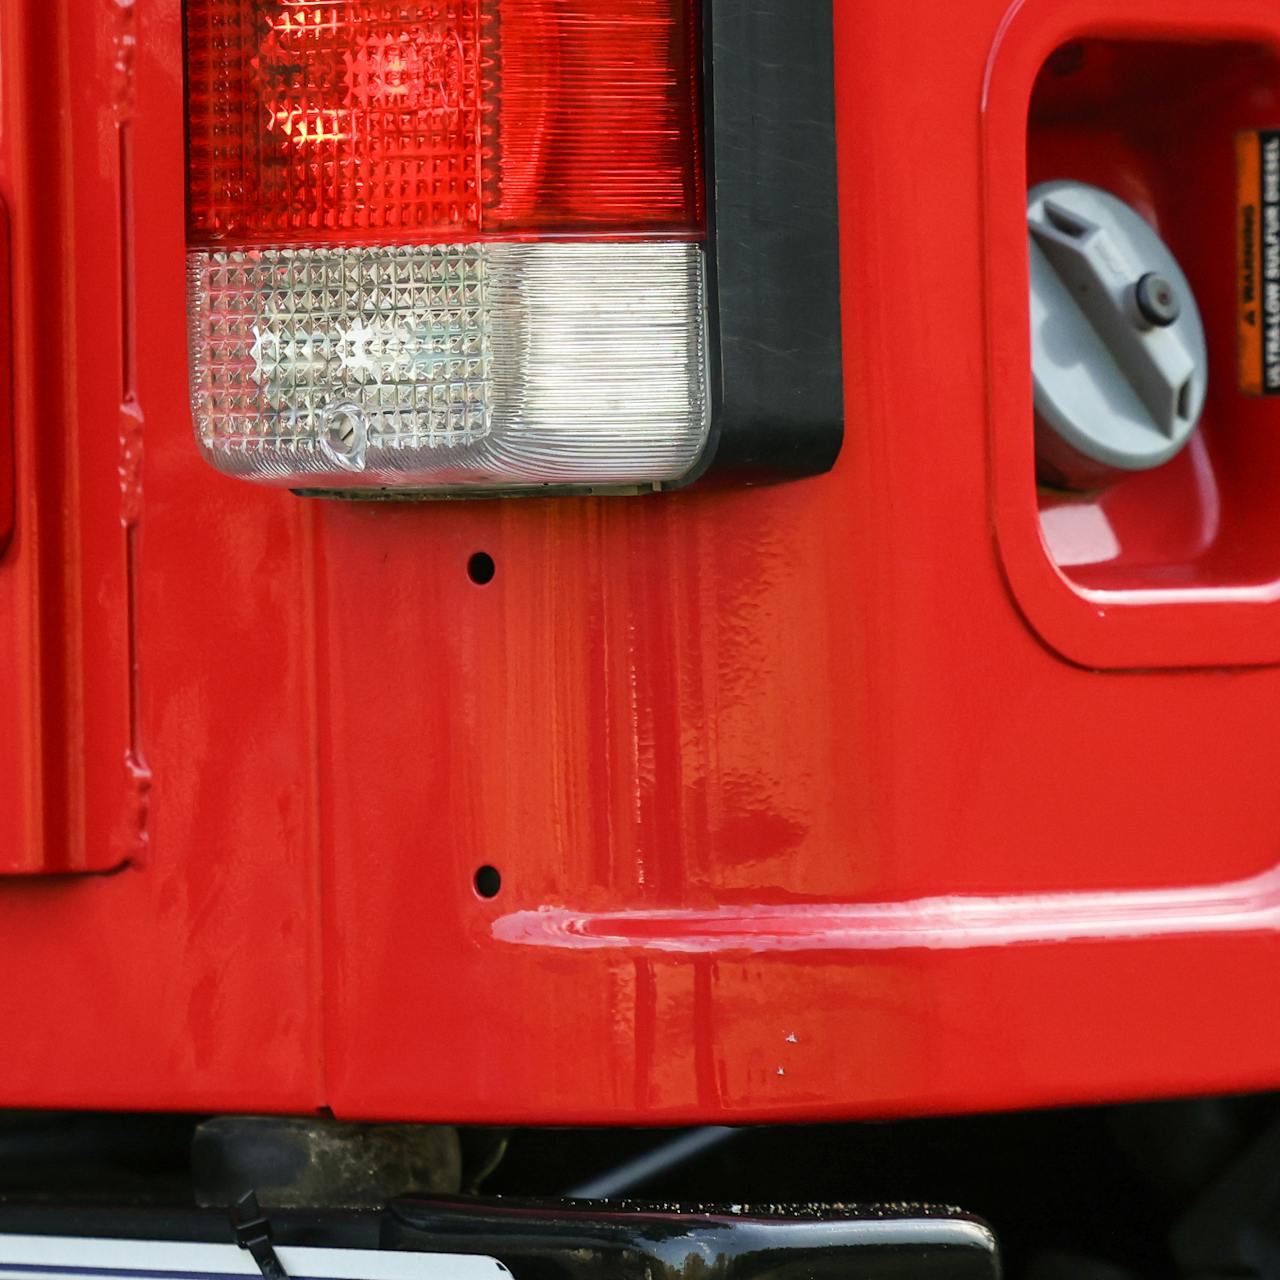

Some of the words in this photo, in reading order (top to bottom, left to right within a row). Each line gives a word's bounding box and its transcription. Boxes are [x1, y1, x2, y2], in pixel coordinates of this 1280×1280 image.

[1264, 138, 1280, 203] DIESEL
[1242, 205, 1256, 303] WARNING
[1264, 206, 1280, 279] SULFUR
